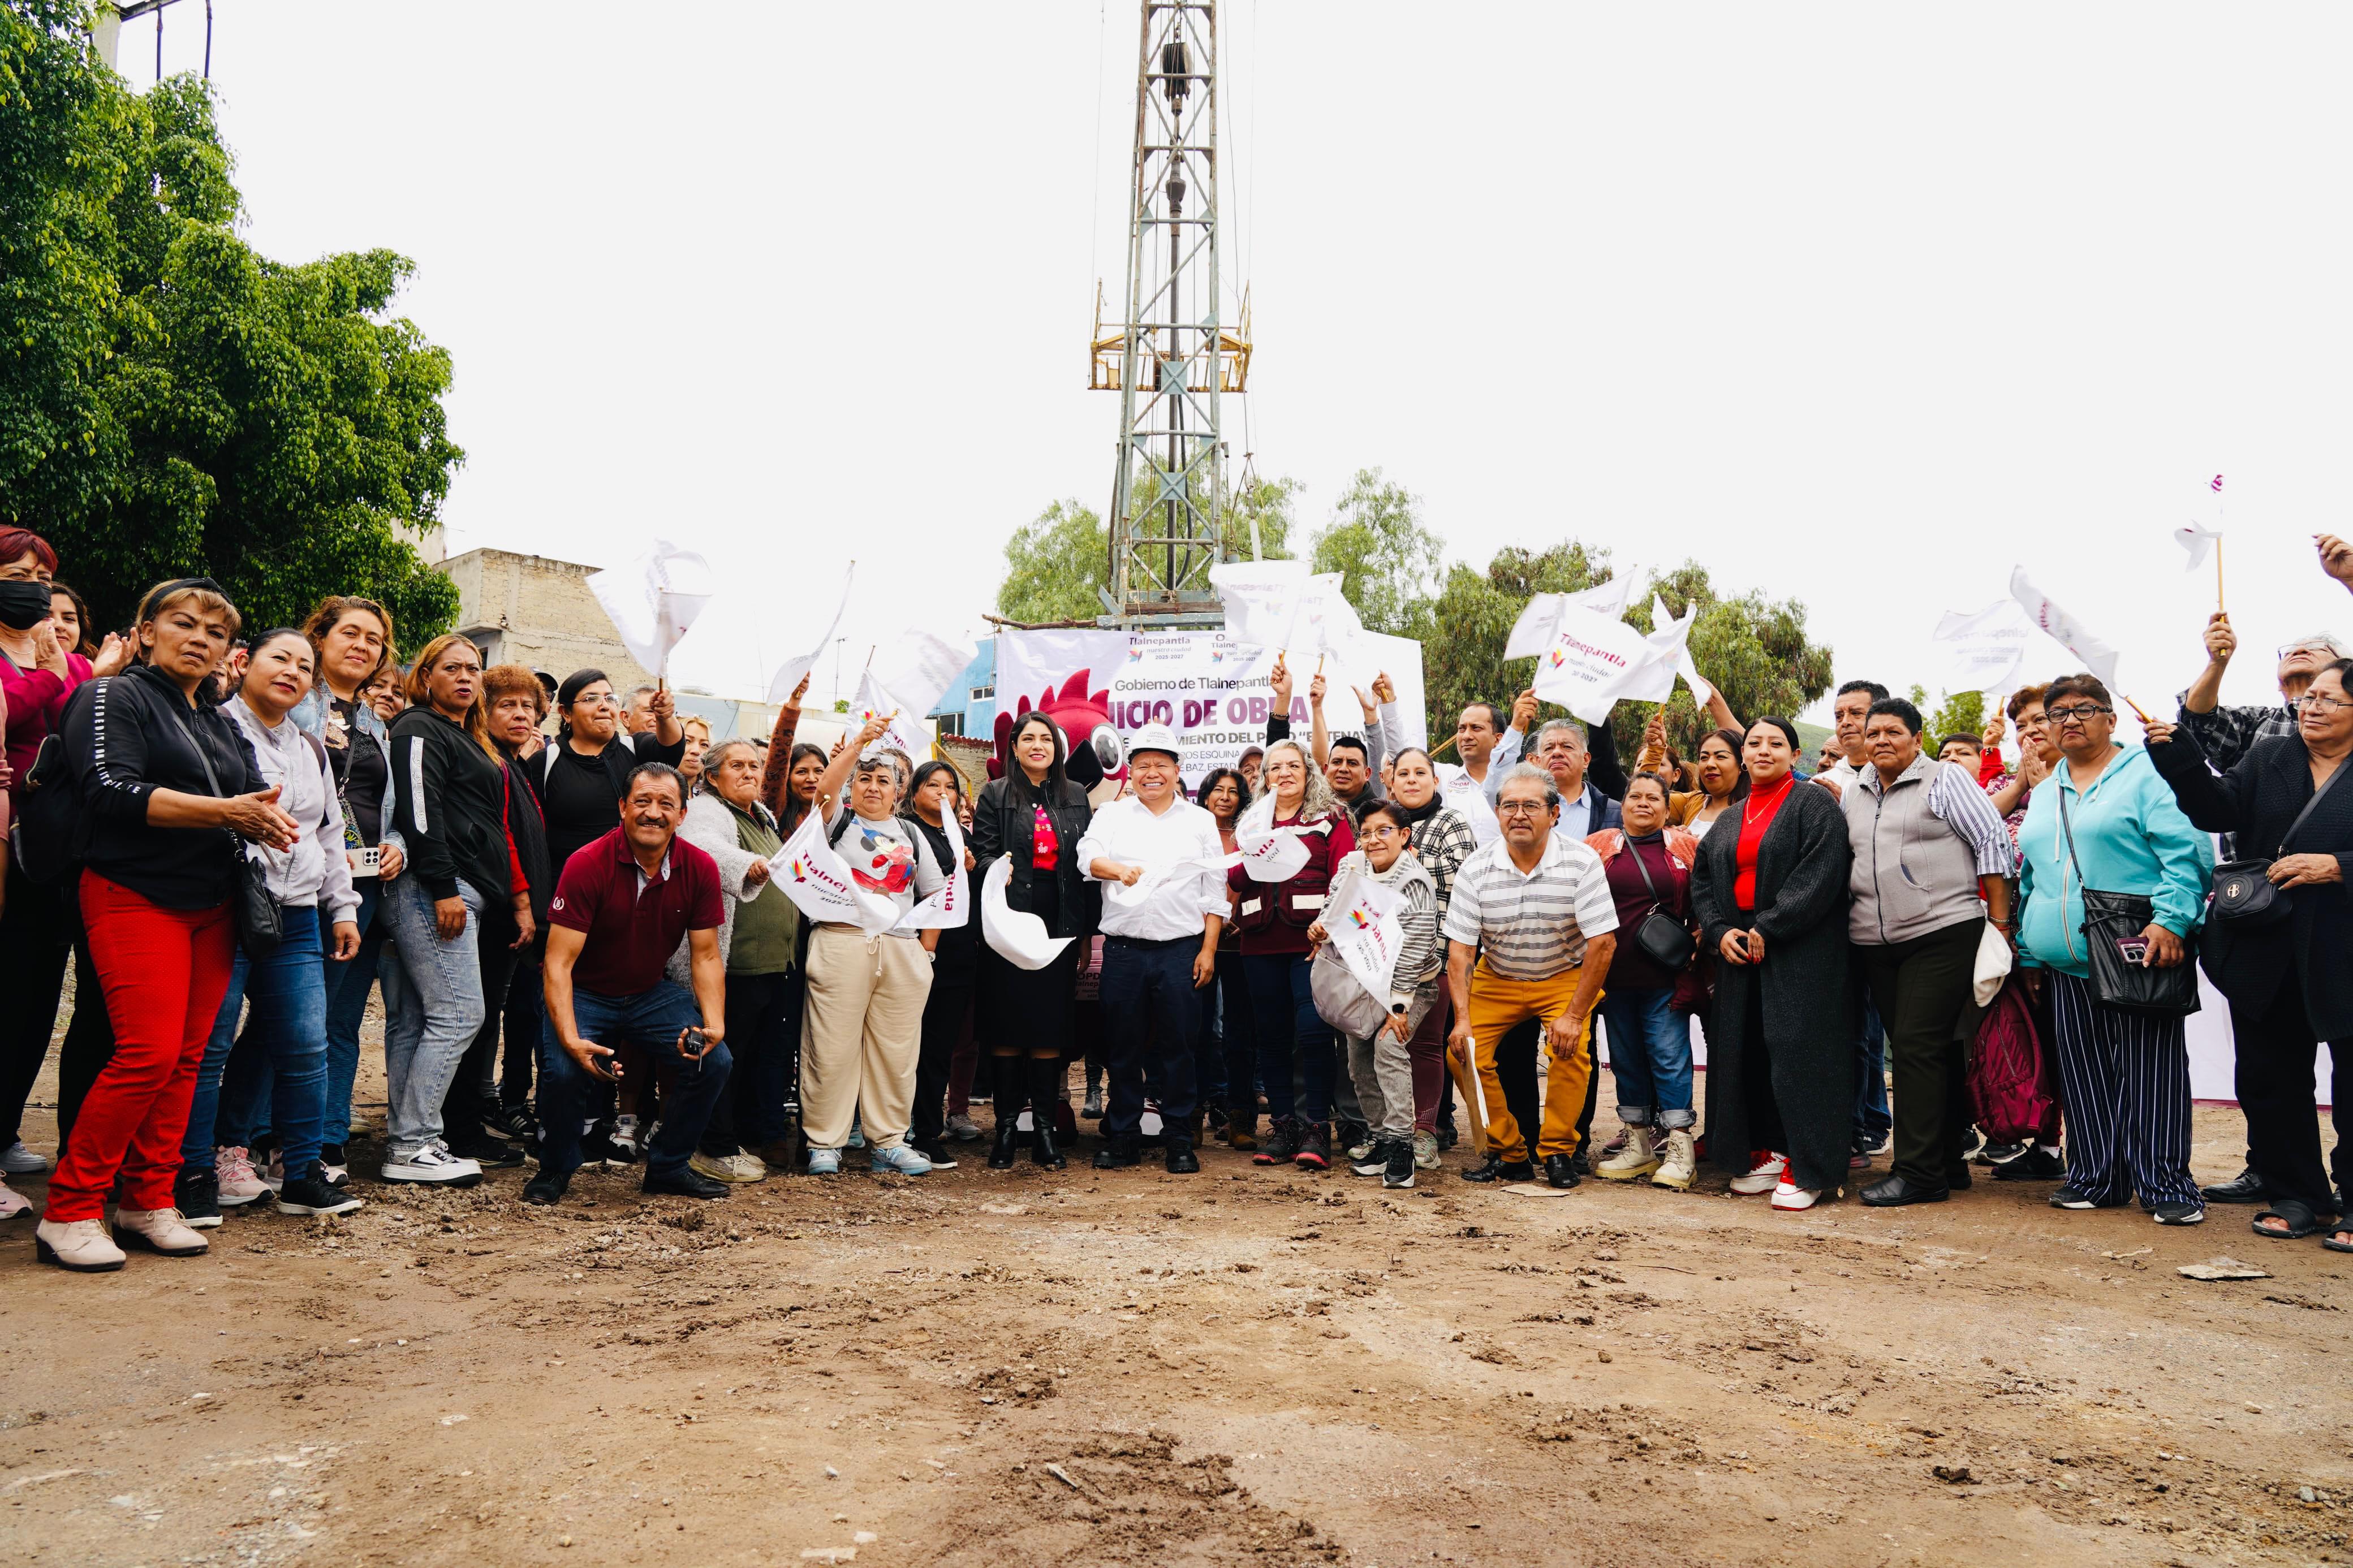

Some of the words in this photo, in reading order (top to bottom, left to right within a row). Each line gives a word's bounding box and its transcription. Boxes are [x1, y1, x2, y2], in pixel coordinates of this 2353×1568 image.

[1130, 637, 1191, 646] Tlalnepantla
[1115, 679, 1176, 691] Gobierno
[1179, 678, 1195, 689] de
[1197, 676, 1272, 691] Tlalnepantl
[1183, 699, 1217, 728] DE
[1229, 732, 1255, 743] DEL
[1257, 732, 1296, 742] PO
[1200, 750, 1239, 759] ESQUINA
[1186, 763, 1206, 772] BAZ,
[1208, 762, 1236, 771] ESTAD
[820, 896, 856, 906] 2025-20
